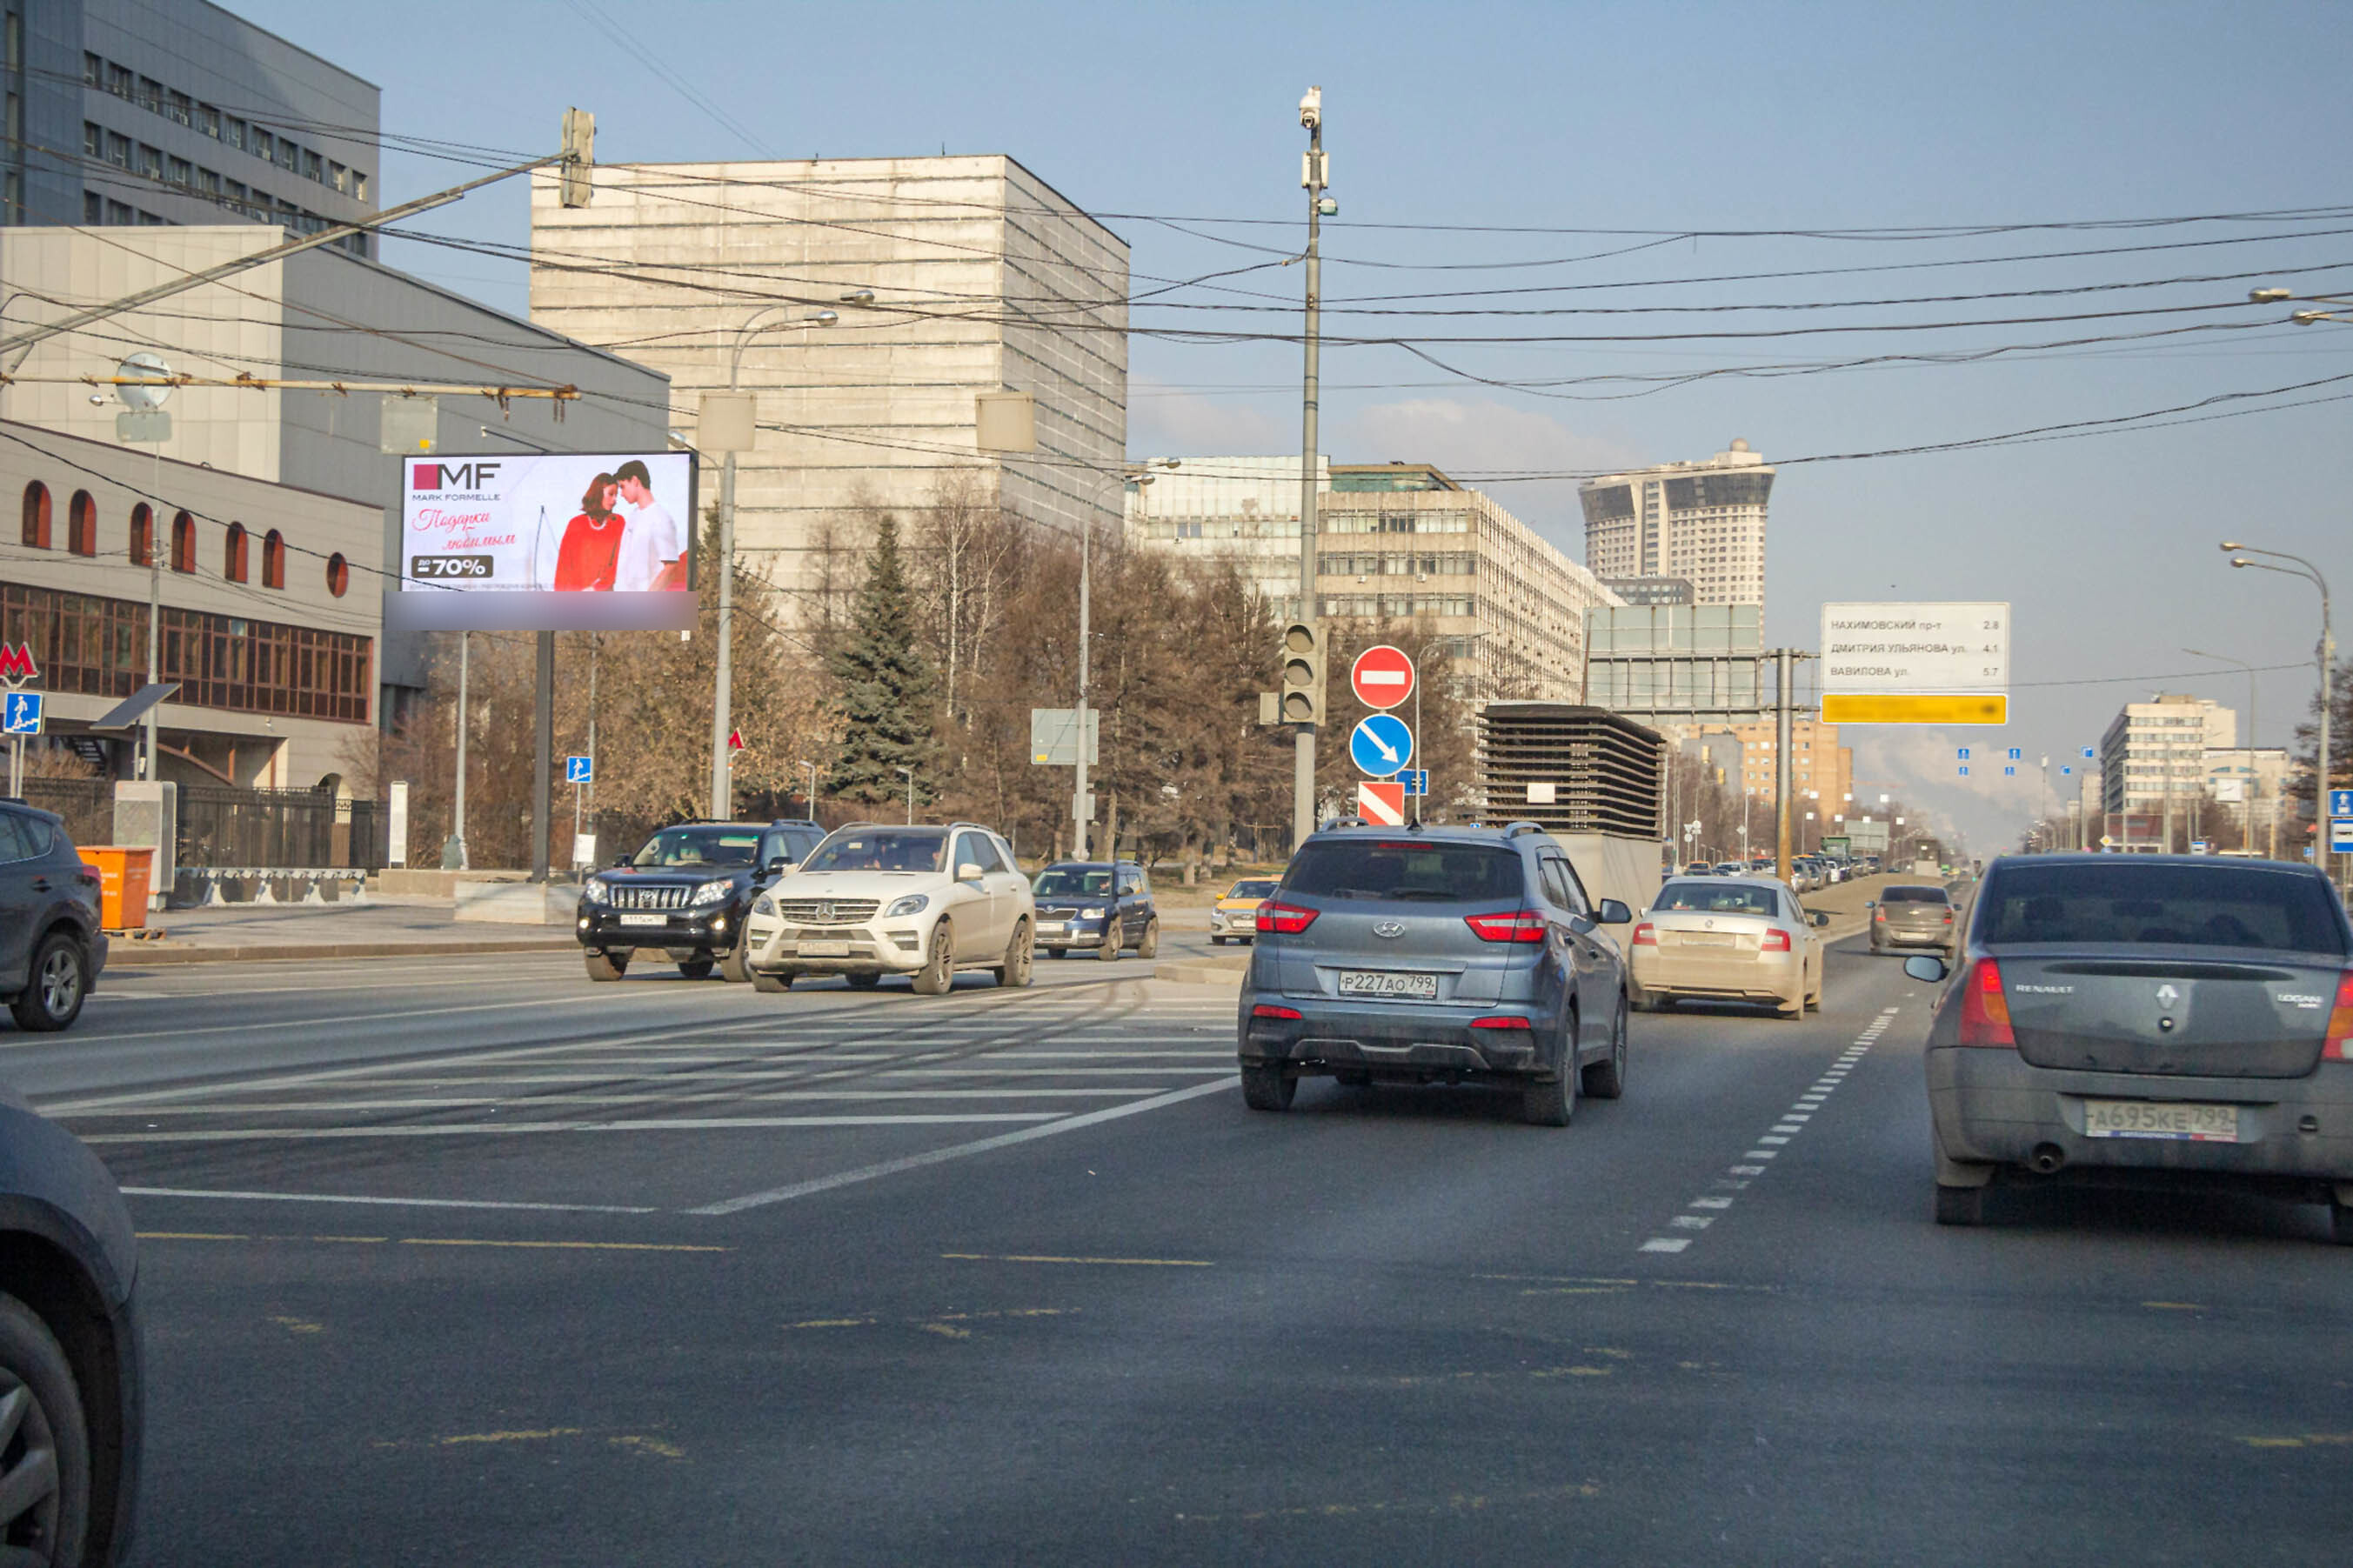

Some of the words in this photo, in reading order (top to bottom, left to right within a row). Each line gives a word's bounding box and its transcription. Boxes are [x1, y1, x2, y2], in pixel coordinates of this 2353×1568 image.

[438, 463, 501, 490] MF
[412, 493, 442, 502] MARK
[445, 493, 501, 502] FORMELLE
[411, 509, 491, 533] Подарки
[442, 526, 516, 550] любимым
[1831, 619, 1915, 630] НАХИМОВСКИЙ
[1919, 622, 1942, 632] пр-т
[1983, 620, 2000, 630] 2.8
[1831, 644, 1885, 653] ДМИТРИЯ
[1888, 644, 1949, 653] УЛЬЯНОВА
[1982, 644, 1998, 654] 4.1
[1830, 667, 1891, 676] ВАВИЛОВА
[1983, 667, 1998, 676] 5.7
[2015, 984, 2075, 995] RENAULT
[2277, 994, 2323, 1004] LOGAN
